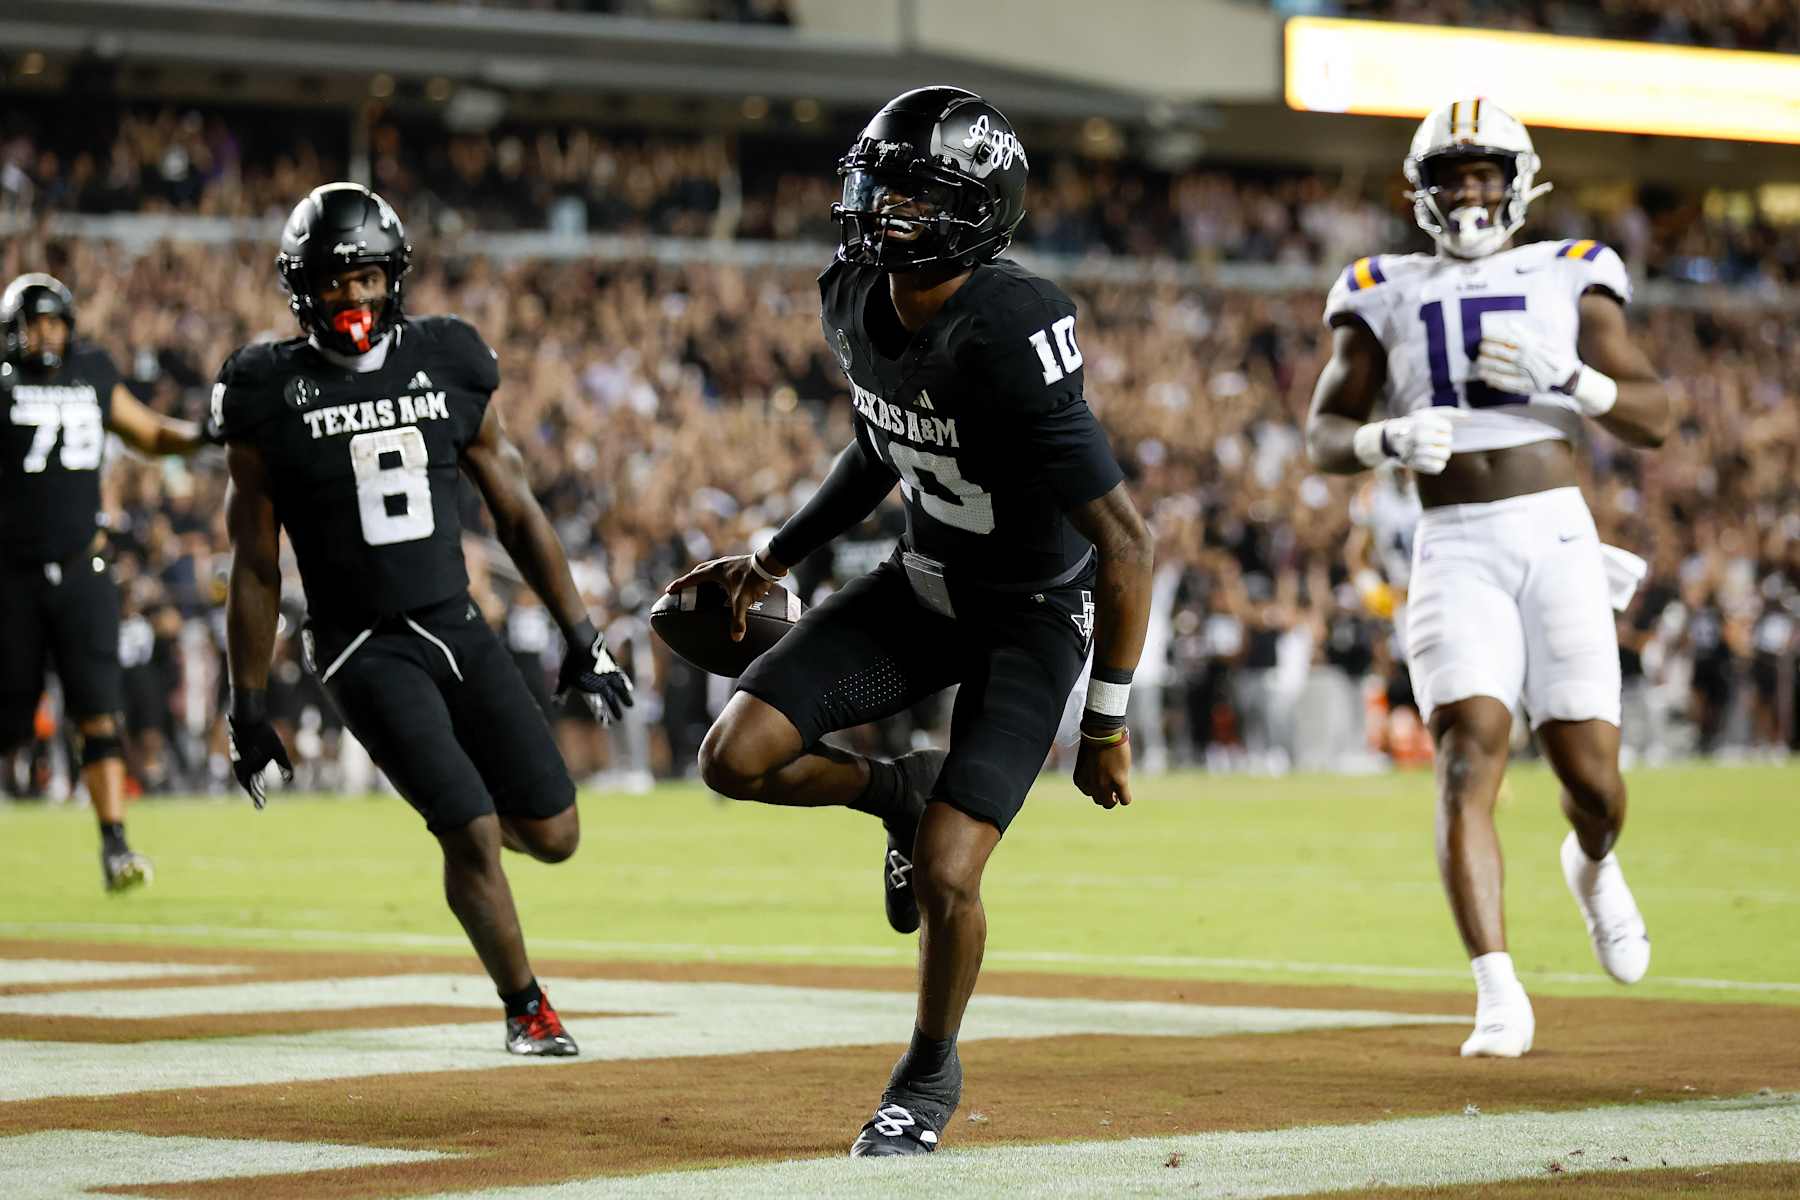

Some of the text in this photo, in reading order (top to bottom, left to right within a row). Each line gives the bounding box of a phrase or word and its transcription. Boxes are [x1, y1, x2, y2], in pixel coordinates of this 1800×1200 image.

[1028, 314, 1084, 386] 10
[1420, 296, 1530, 407] 15
[303, 391, 450, 439] TEXAS A&M
[847, 372, 960, 448] TEXAS A&M
[350, 426, 435, 546] 8
